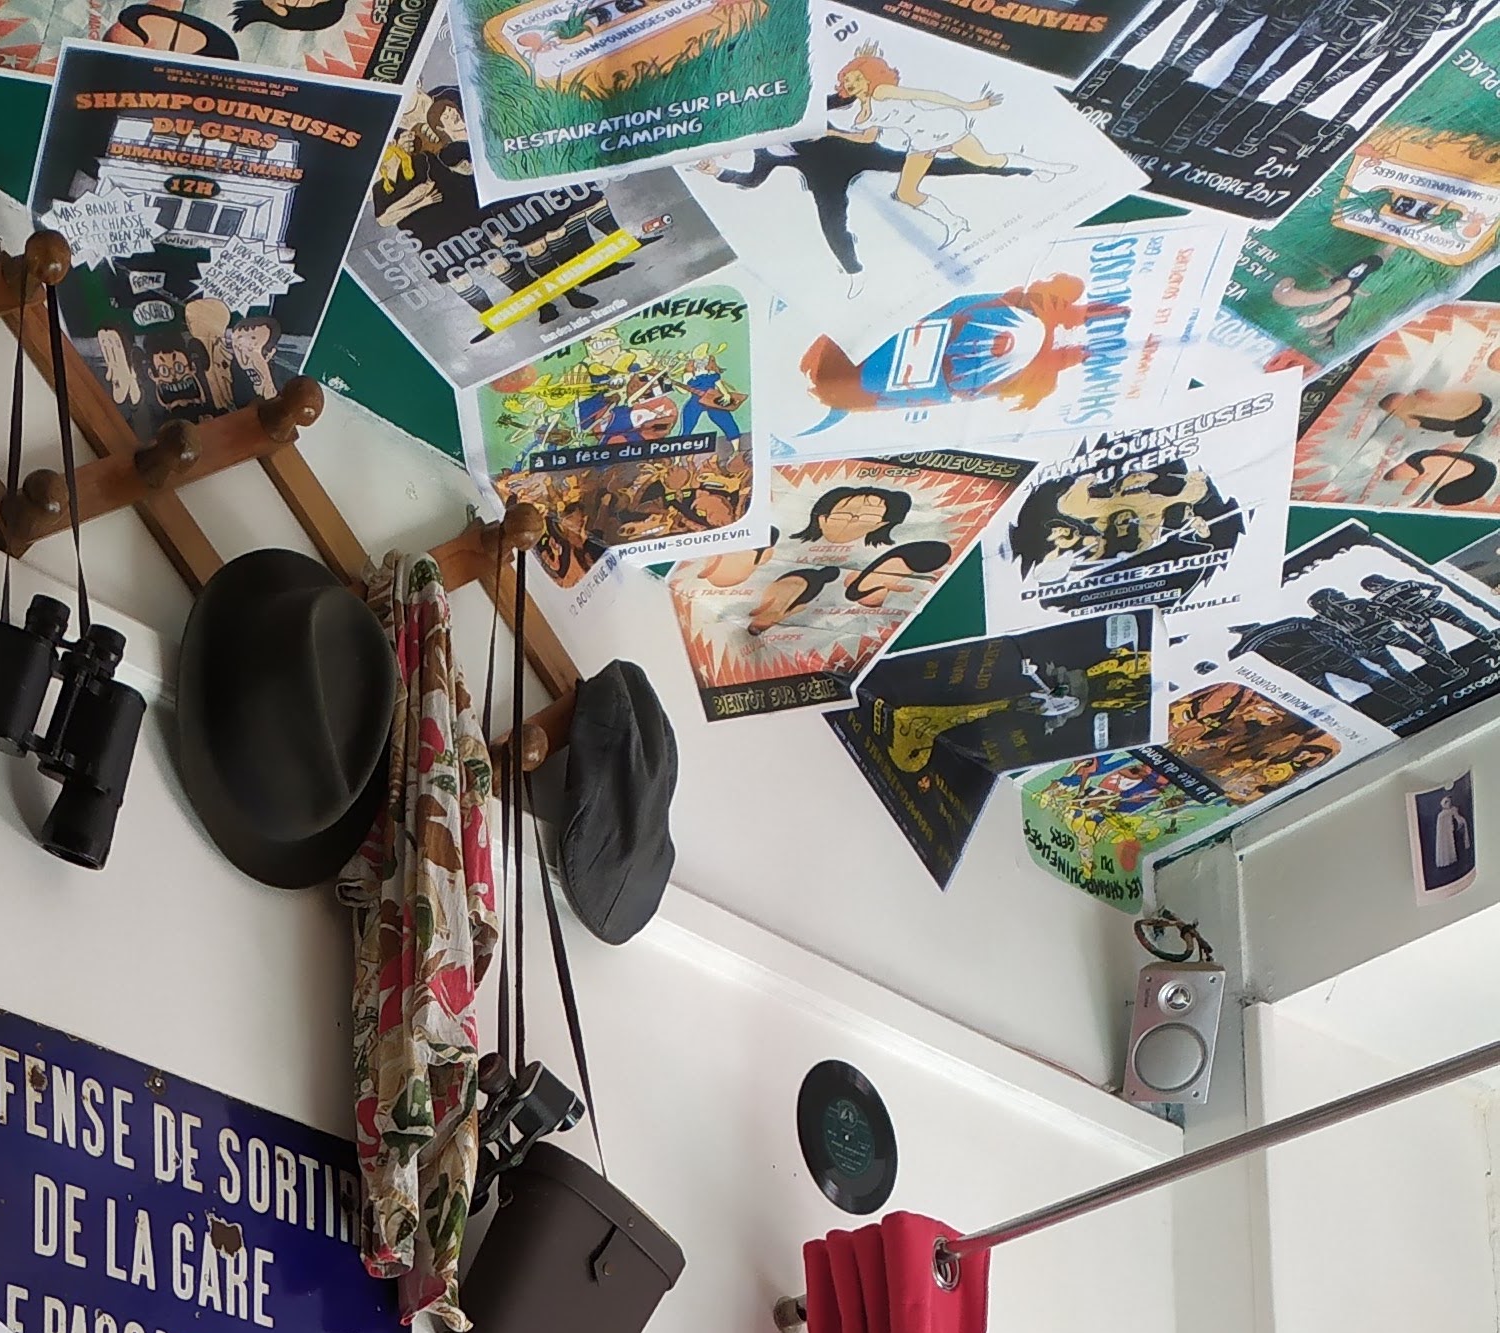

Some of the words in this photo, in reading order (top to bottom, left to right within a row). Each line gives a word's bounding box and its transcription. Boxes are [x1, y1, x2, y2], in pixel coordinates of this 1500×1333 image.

[76, 92, 362, 148] SHAMPOUINEUSES
[150, 116, 195, 135] DU
[200, 120, 279, 149] GERS
[503, 102, 661, 154] RESTAURATION
[667, 94, 710, 115] SUR
[716, 80, 790, 107] PLACE
[600, 116, 703, 152] CAMPING
[108, 142, 217, 169] DIMANCHE
[223, 157, 244, 172] 27
[247, 160, 305, 181] MARS
[170, 177, 215, 196] 17H
[1243, 184, 1292, 208] 2017
[364, 229, 423, 270] LES
[400, 280, 446, 312] DU
[628, 319, 687, 347] GERS
[552, 454, 566, 466] la
[576, 446, 611, 464] fête
[618, 444, 642, 458] du
[650, 436, 710, 456] Poney!
[884, 466, 921, 479] GERS
[1020, 570, 1143, 602] DIMANCHE
[1145, 563, 1170, 577] 21
[1169, 549, 1231, 572] JUIN
[770, 681, 798, 706] SUR
[153, 1102, 204, 1194] DE
[33, 1173, 88, 1269] DE
[106, 1195, 157, 1292] LA
[172, 1221, 277, 1329] GARE
